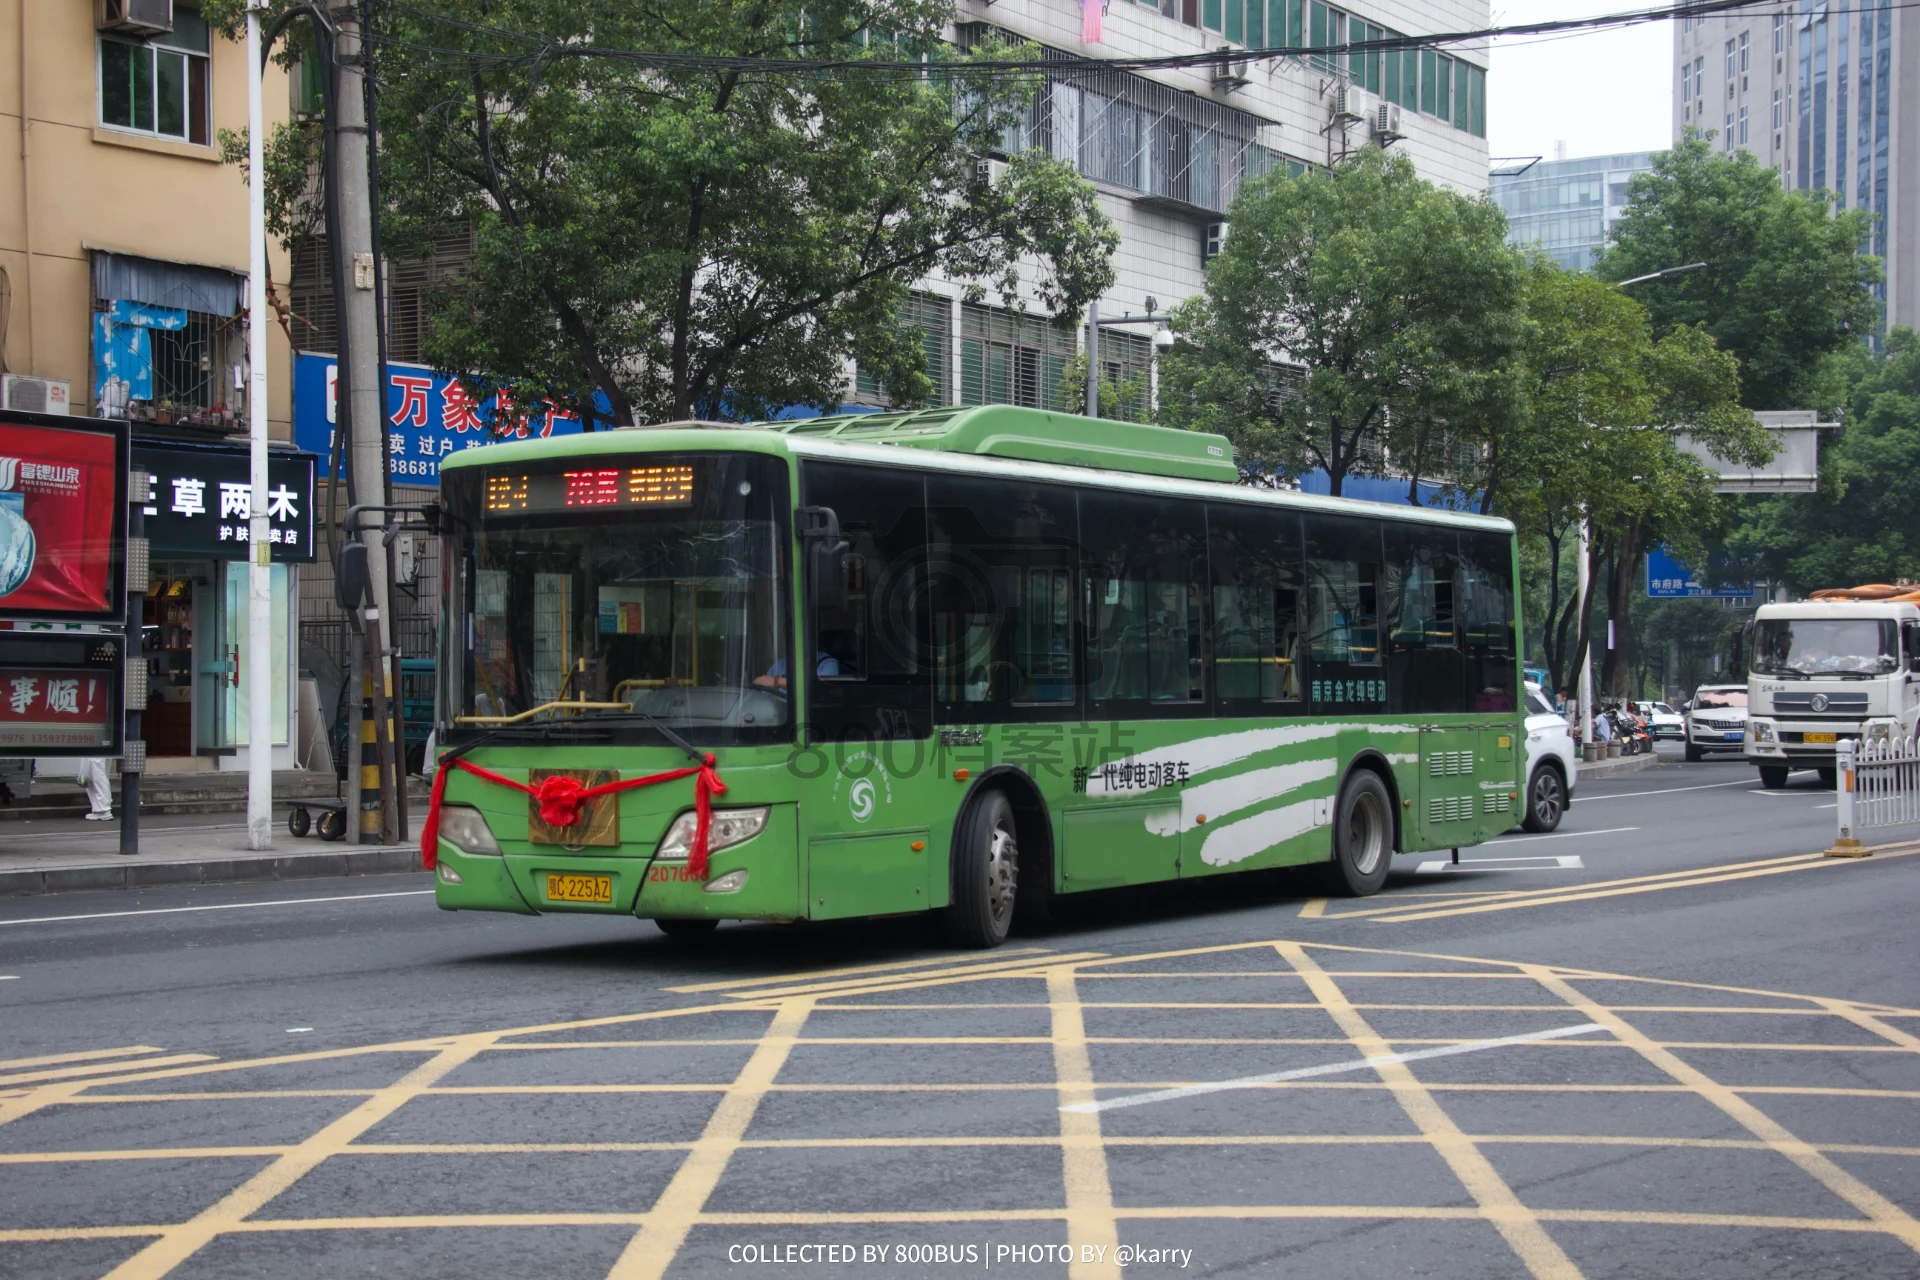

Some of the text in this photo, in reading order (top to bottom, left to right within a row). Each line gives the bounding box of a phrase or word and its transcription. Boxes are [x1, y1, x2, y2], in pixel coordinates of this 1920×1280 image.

[219, 525, 298, 545] 护肤卖店
[1651, 579, 1683, 590] 市府路
[0, 676, 97, 714] 事顺!
[1312, 680, 1386, 702] 南京金龙纯电动
[0, 733, 25, 743] 9976
[1072, 761, 1190, 793] 新一代纯电动客车
